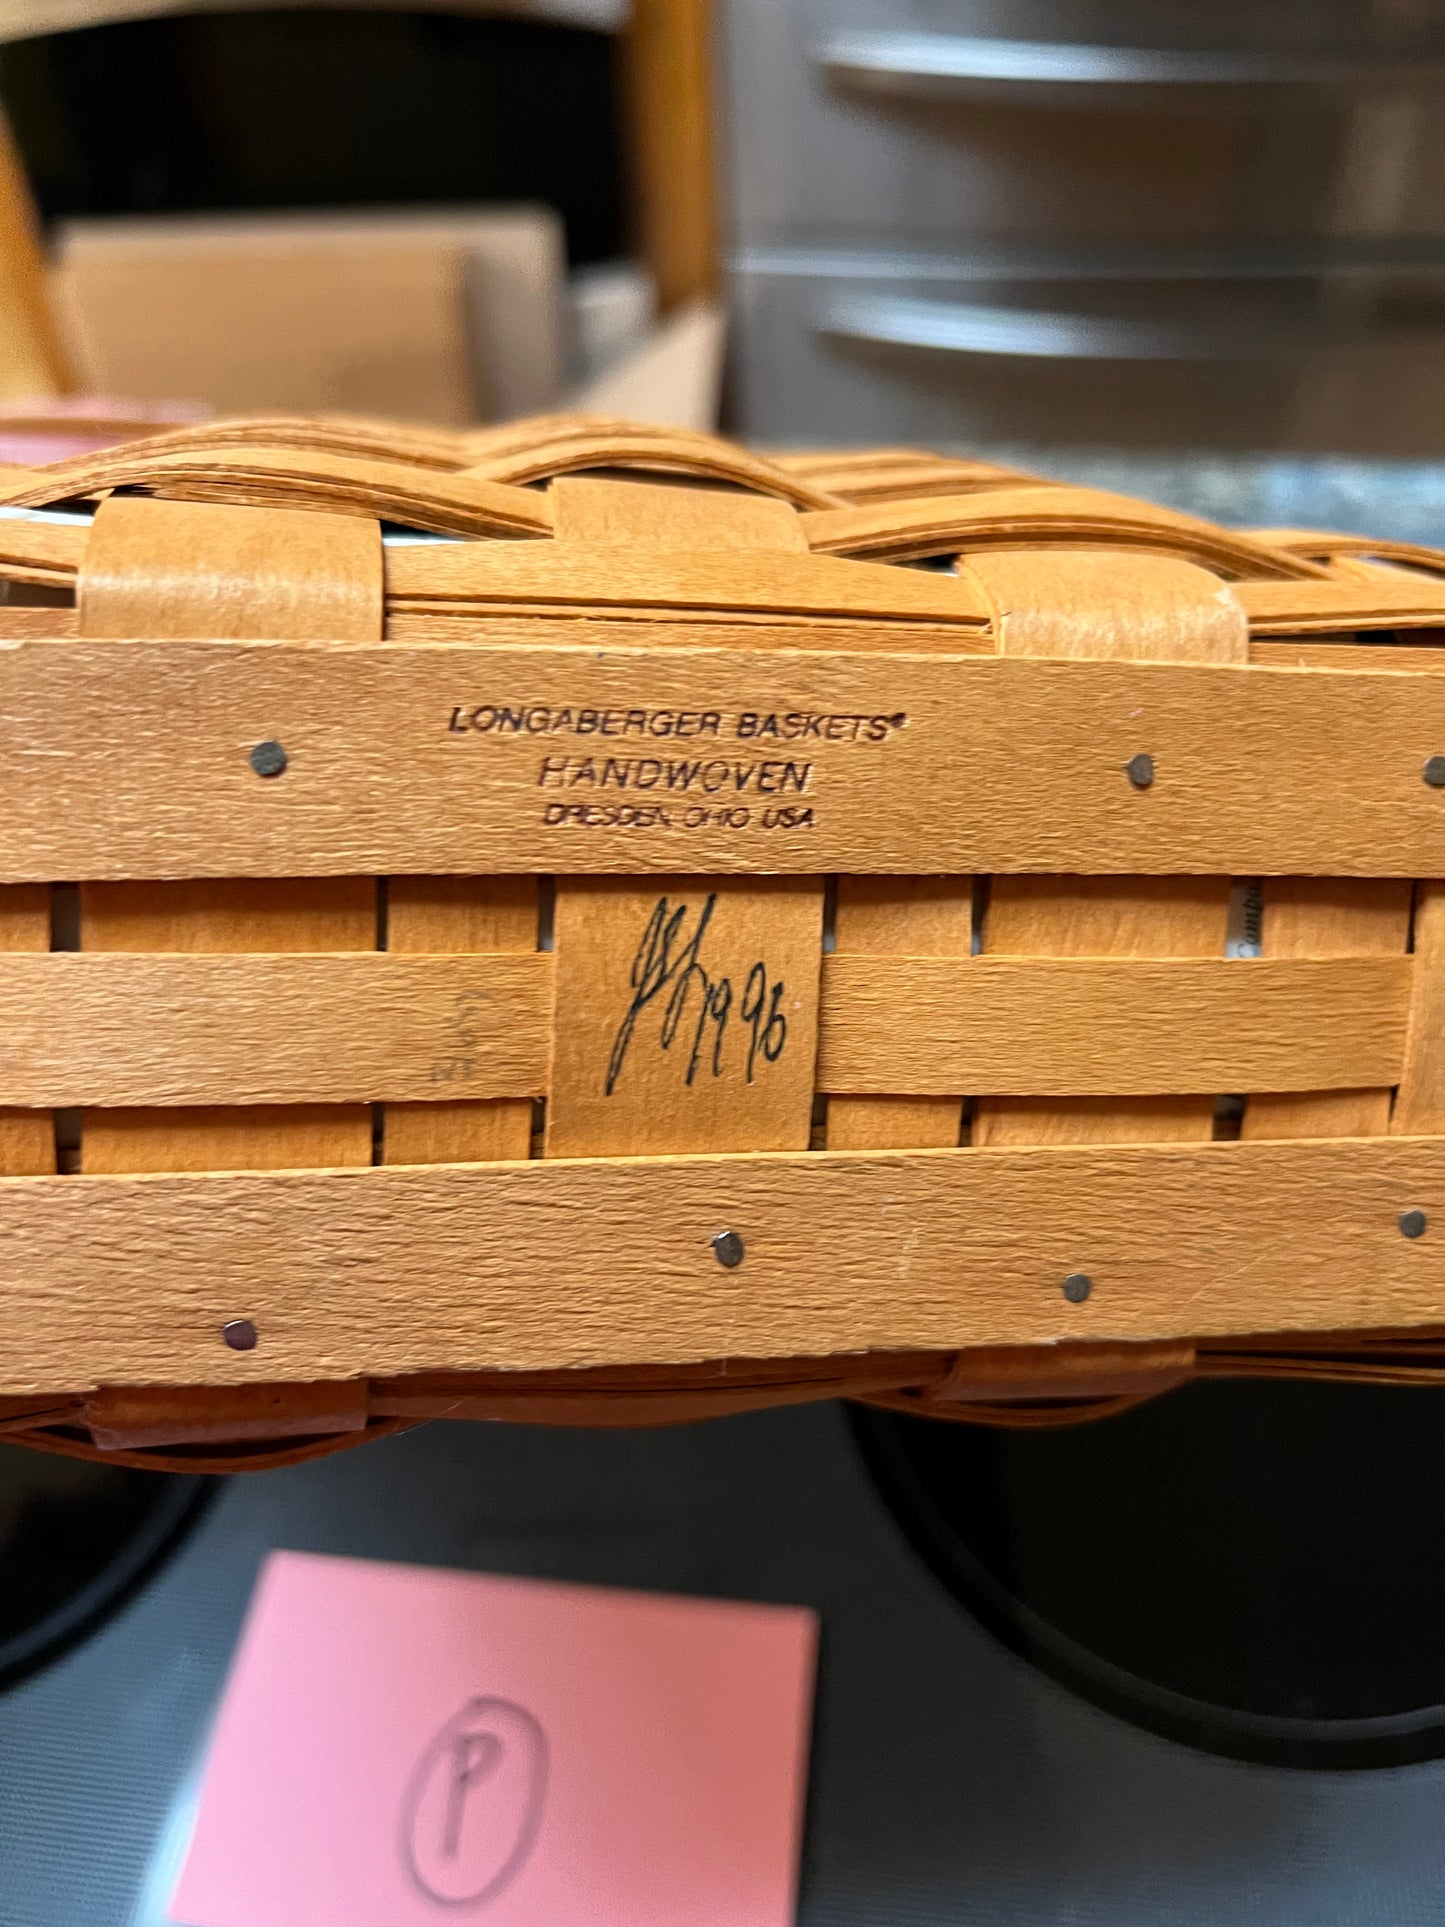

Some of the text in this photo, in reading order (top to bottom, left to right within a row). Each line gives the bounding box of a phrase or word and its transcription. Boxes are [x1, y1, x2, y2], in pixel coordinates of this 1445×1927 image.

[448, 706, 720, 738] LONGABERGER
[537, 756, 813, 793] HANDWOVEN
[683, 806, 750, 829] OHIO
[760, 806, 815, 829] USA
[442, 1731, 503, 1860] P
